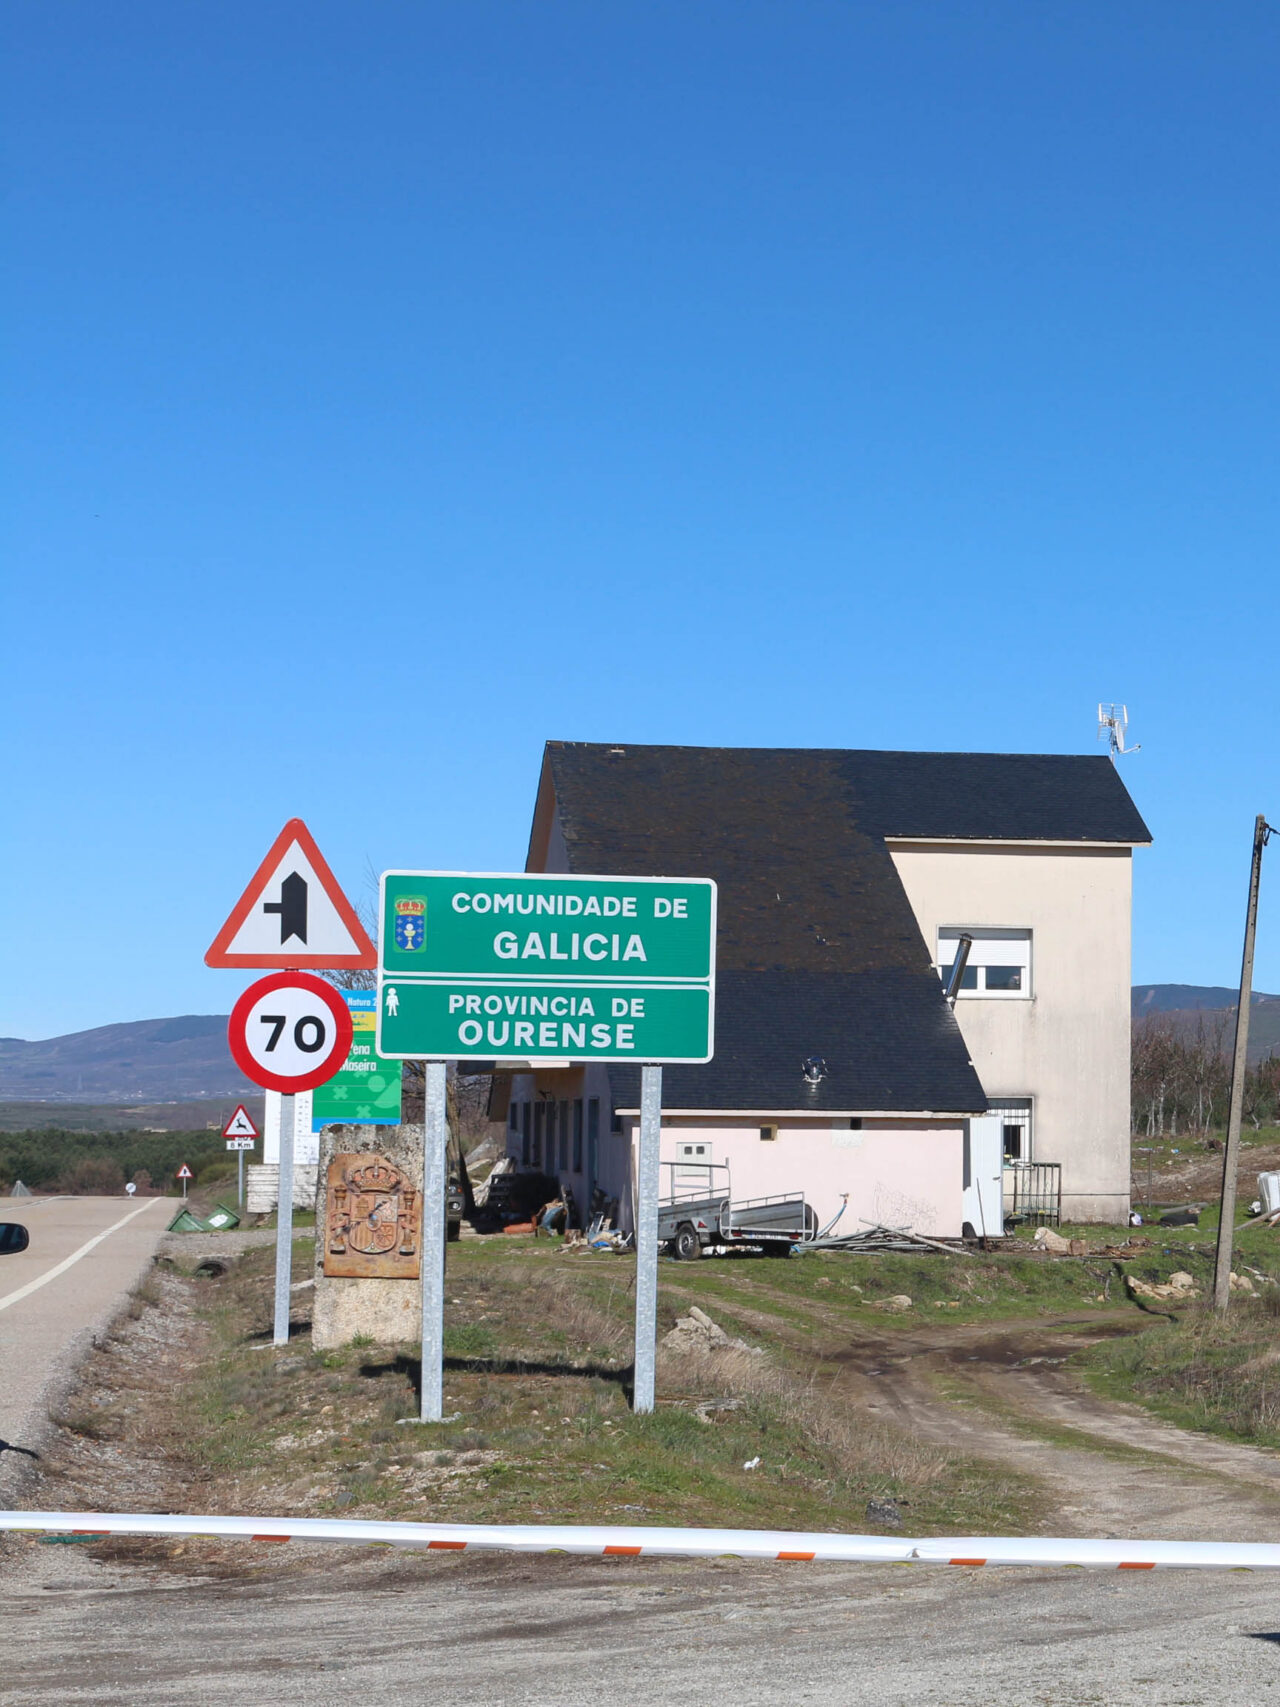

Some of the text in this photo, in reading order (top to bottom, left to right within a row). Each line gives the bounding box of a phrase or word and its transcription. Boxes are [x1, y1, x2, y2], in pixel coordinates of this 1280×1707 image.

[451, 892, 688, 919] COMUNIDADE DE
[493, 931, 647, 962] GALICIA
[448, 994, 645, 1018] PROVINCIA DE
[260, 1014, 327, 1053] 70
[458, 1019, 636, 1049] OURENSE
[350, 1044, 370, 1055] ena
